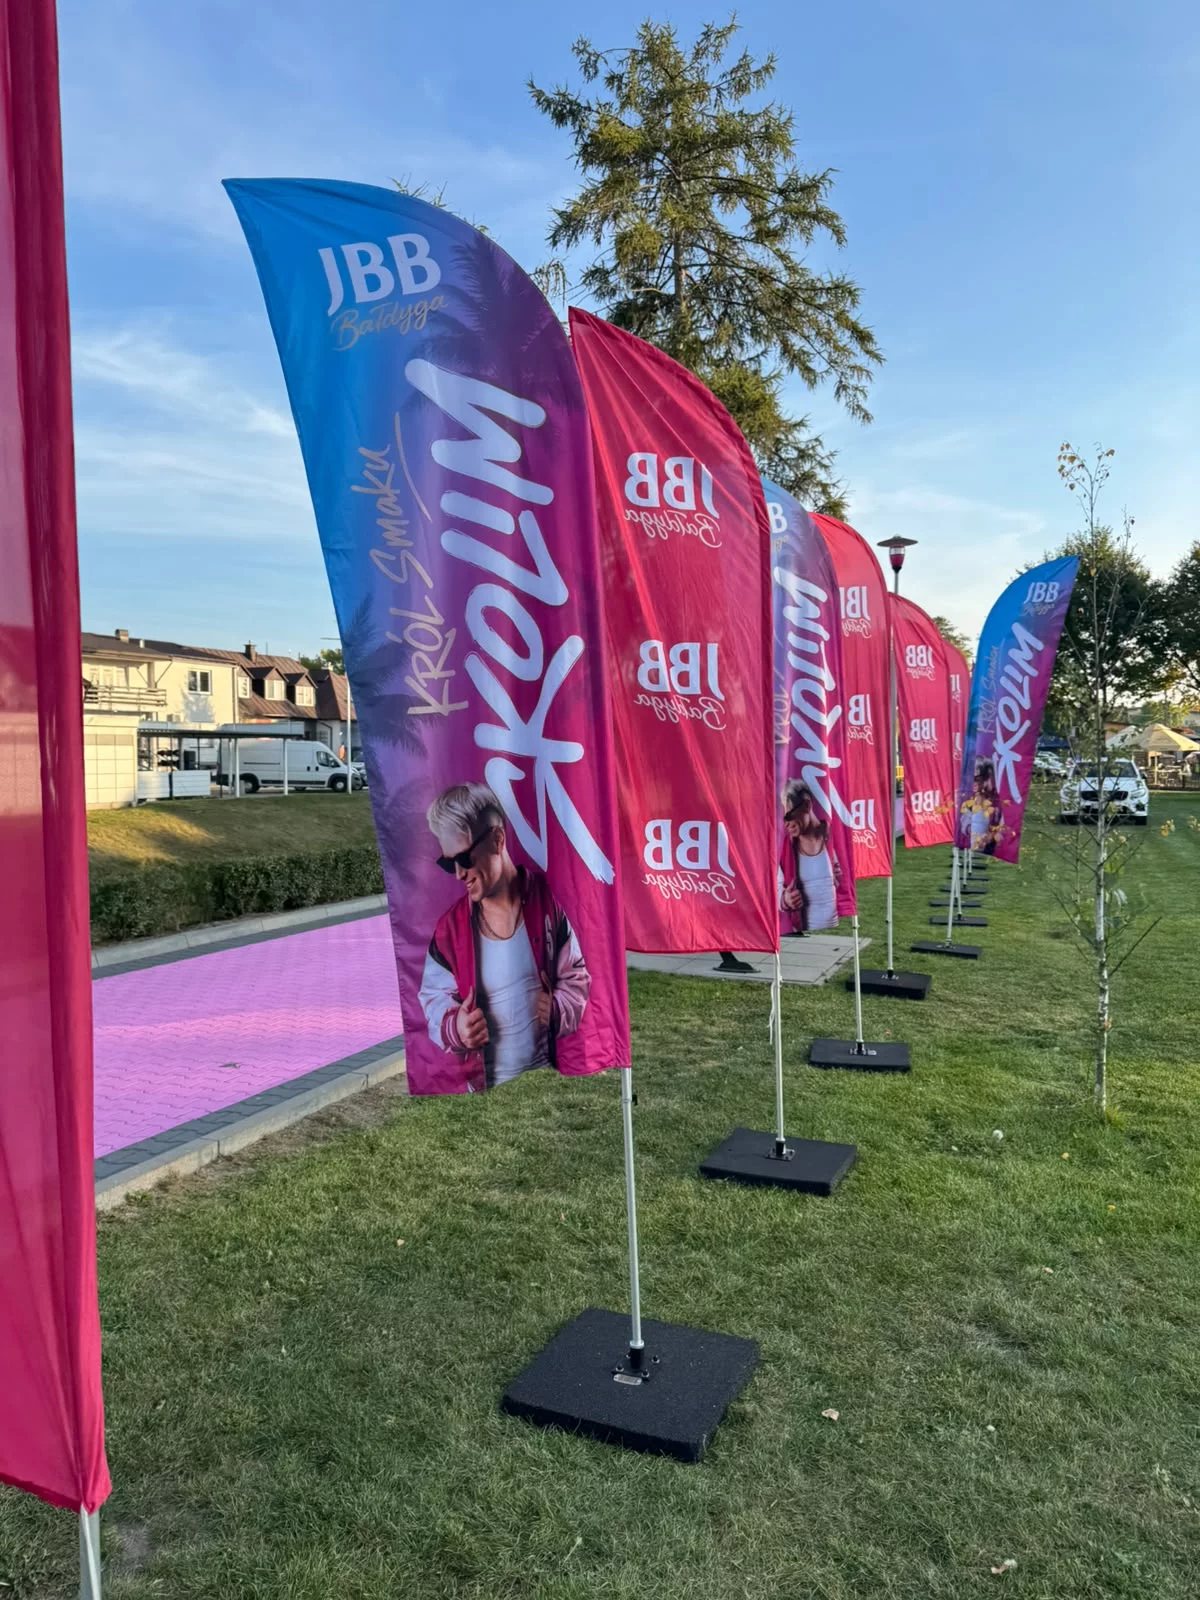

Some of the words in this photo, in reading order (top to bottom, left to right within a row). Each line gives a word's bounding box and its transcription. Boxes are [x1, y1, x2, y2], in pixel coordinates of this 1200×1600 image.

[318, 233, 441, 317] JBB
[330, 296, 448, 352] Bałdyga
[404, 358, 615, 884] SKOLIM
[1024, 582, 1060, 604] JBB
[386, 596, 469, 716] KRÓL
